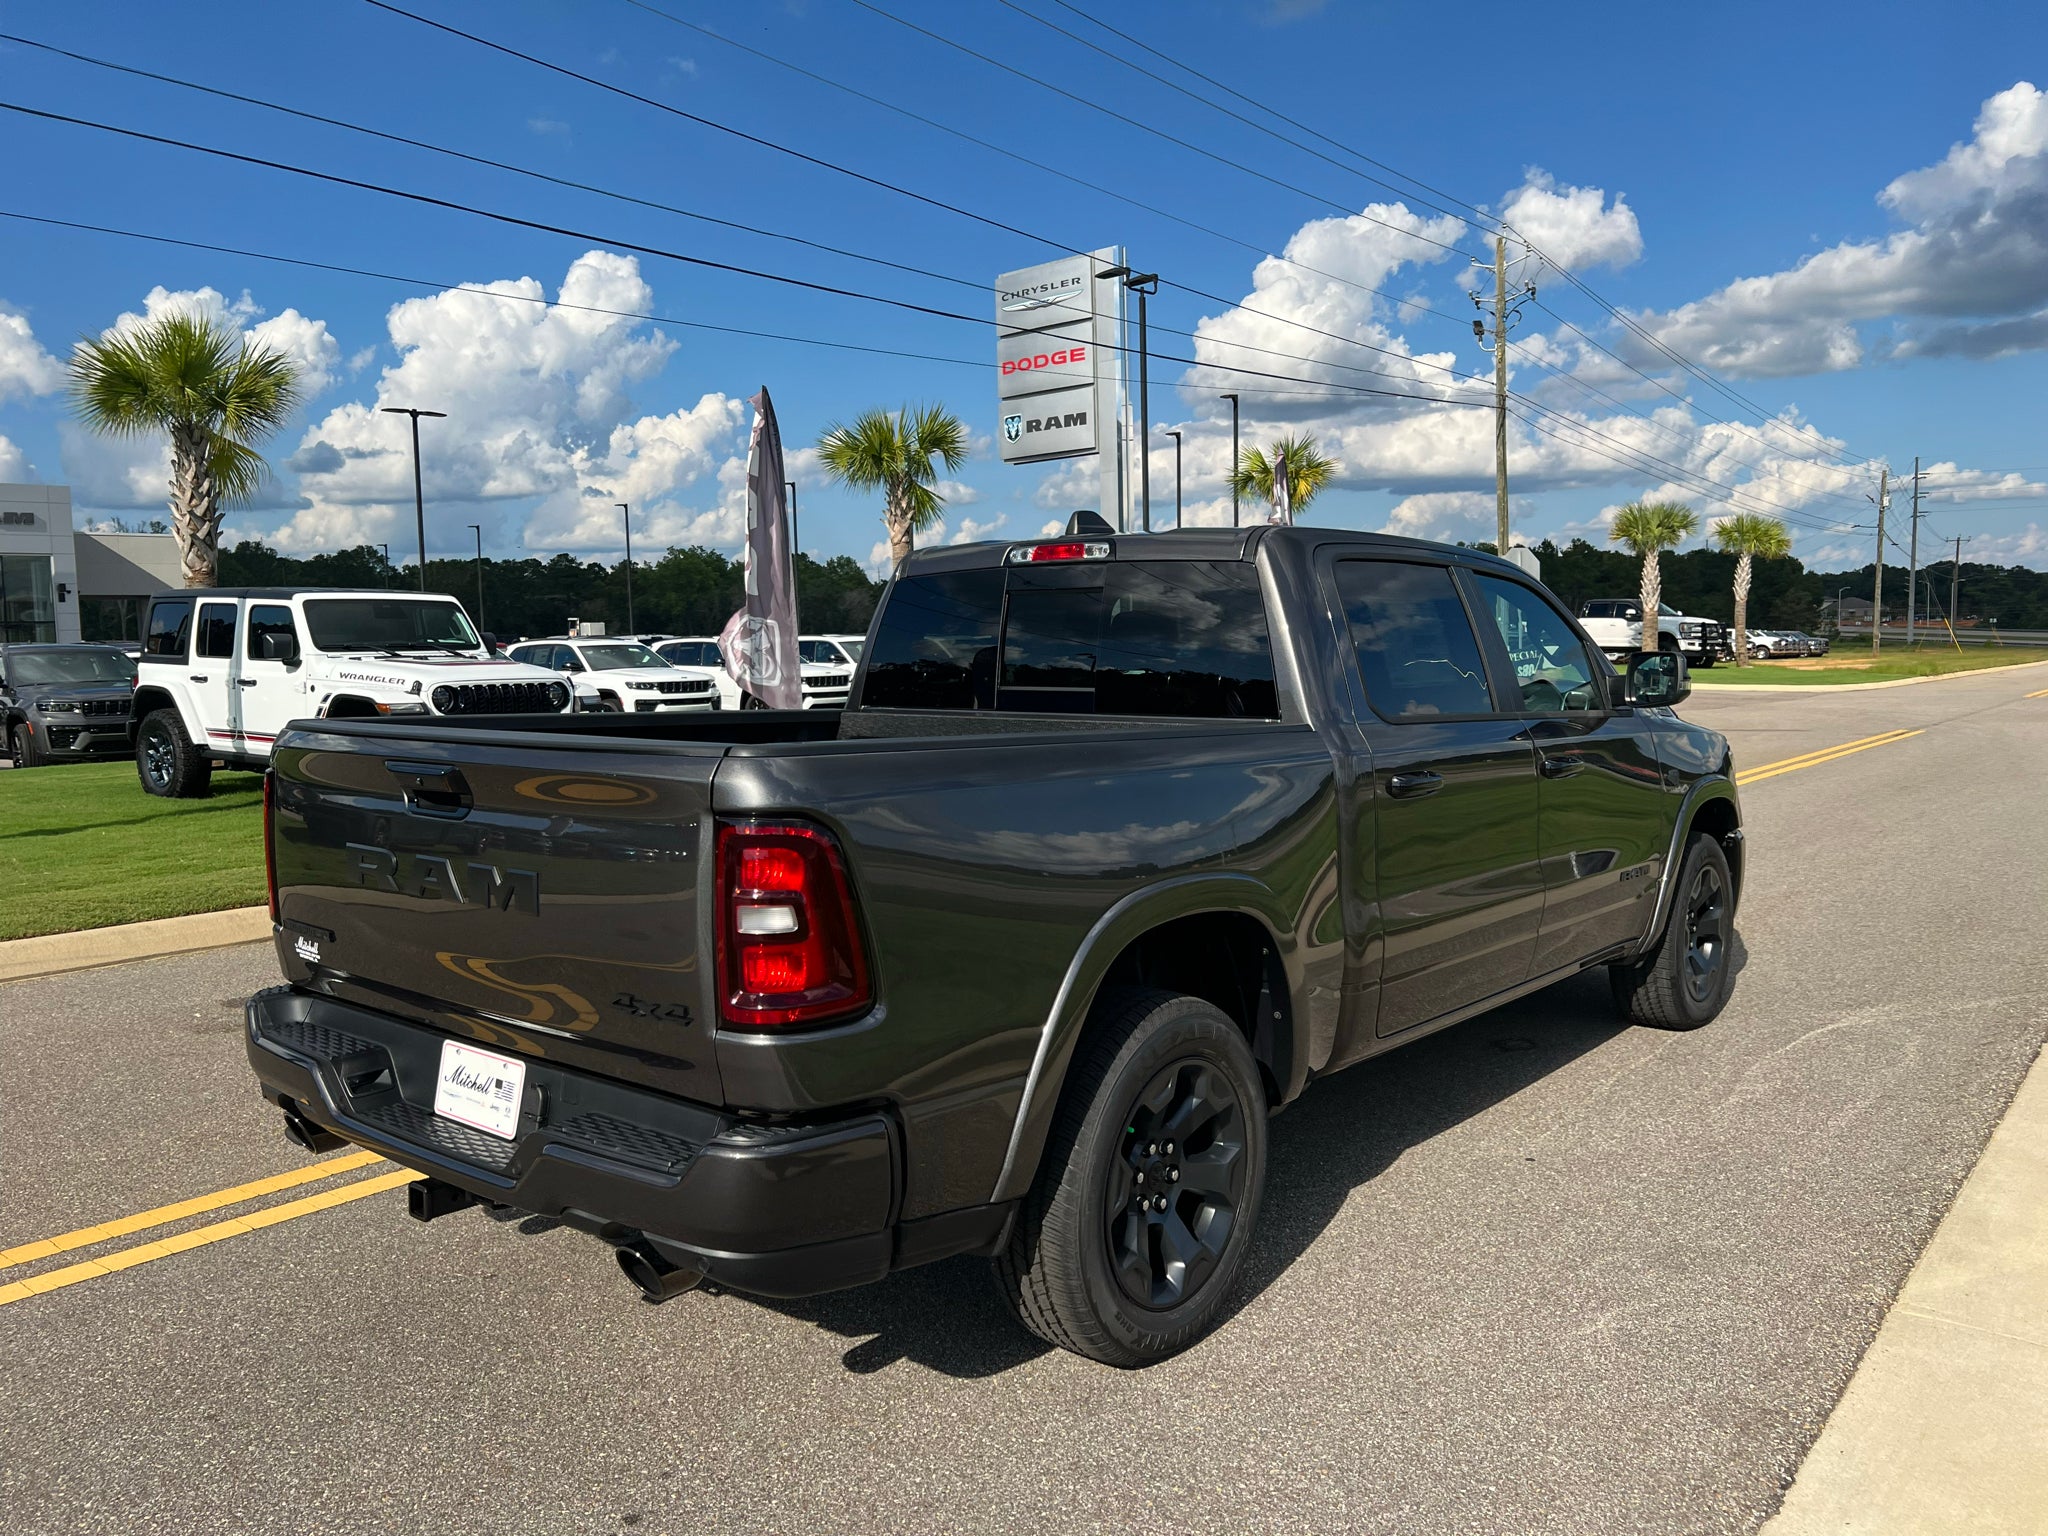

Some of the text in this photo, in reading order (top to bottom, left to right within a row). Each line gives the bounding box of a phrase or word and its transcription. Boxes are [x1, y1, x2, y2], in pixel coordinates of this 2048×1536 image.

[1001, 277, 1081, 302] CHRYSLER
[1002, 347, 1086, 375] DODGE
[1026, 412, 1087, 433] RAM
[339, 672, 406, 685] WRANGLER
[346, 842, 540, 917] RAM
[444, 1064, 495, 1095] Mitchell
